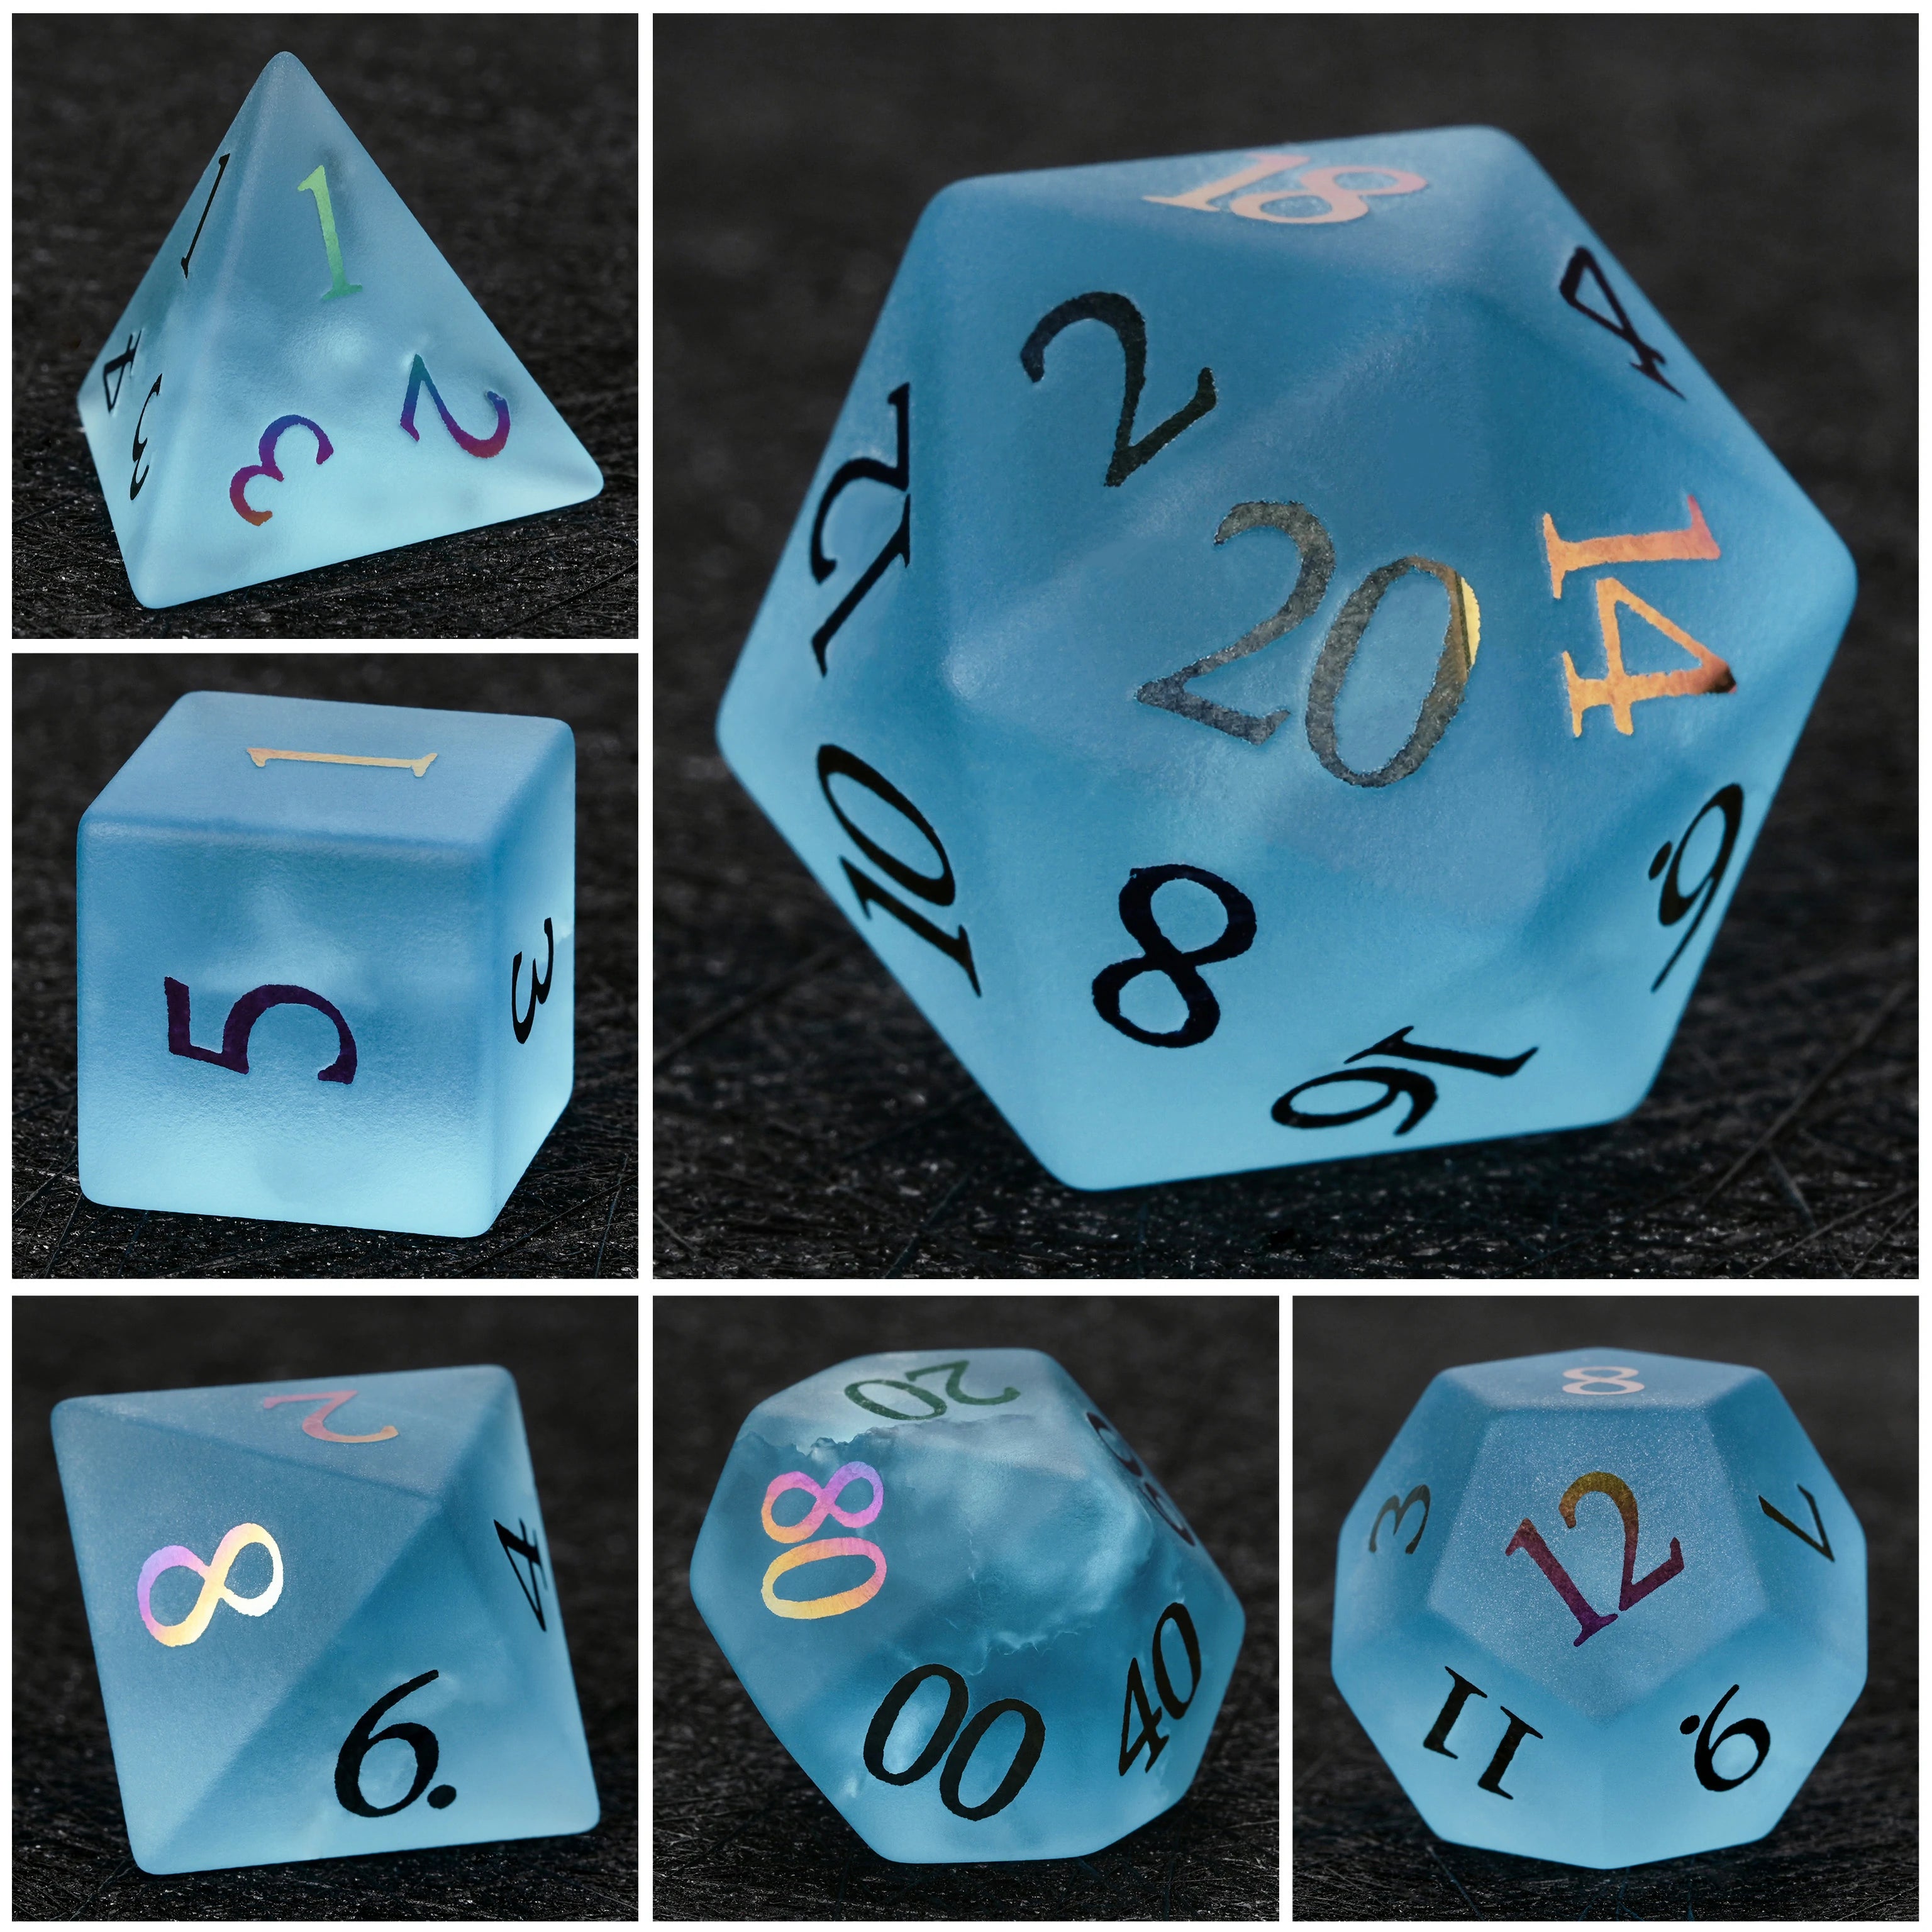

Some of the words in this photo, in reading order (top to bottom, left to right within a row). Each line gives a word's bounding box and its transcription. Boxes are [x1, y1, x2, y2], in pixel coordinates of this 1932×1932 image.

[181, 153, 230, 279] 1
[297, 165, 363, 301] 1
[1142, 153, 1426, 223] 18
[104, 330, 142, 413] 4
[1559, 247, 1686, 401] 4
[130, 374, 162, 501] 3
[401, 353, 510, 458] 2
[1020, 291, 1216, 487] 2
[230, 414, 333, 526] 3
[809, 382, 911, 677] 12
[1135, 501, 1480, 788] 20
[1542, 495, 1736, 737] 14
[247, 747, 436, 777] 1
[816, 744, 981, 997] 10
[512, 918, 553, 1044] 3
[1091, 863, 1257, 1048] 8
[164, 977, 357, 1084] 5
[1271, 1025, 1538, 1135] 16
[263, 1391, 399, 1443] 2
[844, 1360, 1021, 1420] 20
[1562, 1366, 1645, 1396] 8
[494, 1517, 548, 1632] 4
[761, 1461, 887, 1620] 80
[1368, 1485, 1431, 1554] 3
[1505, 1471, 1685, 1647] 12
[1758, 1483, 1835, 1562] 7
[137, 1523, 284, 1647] 8
[863, 1663, 1046, 1821] 00
[1118, 1602, 1202, 1777] 40
[1423, 1667, 1543, 1800] 11
